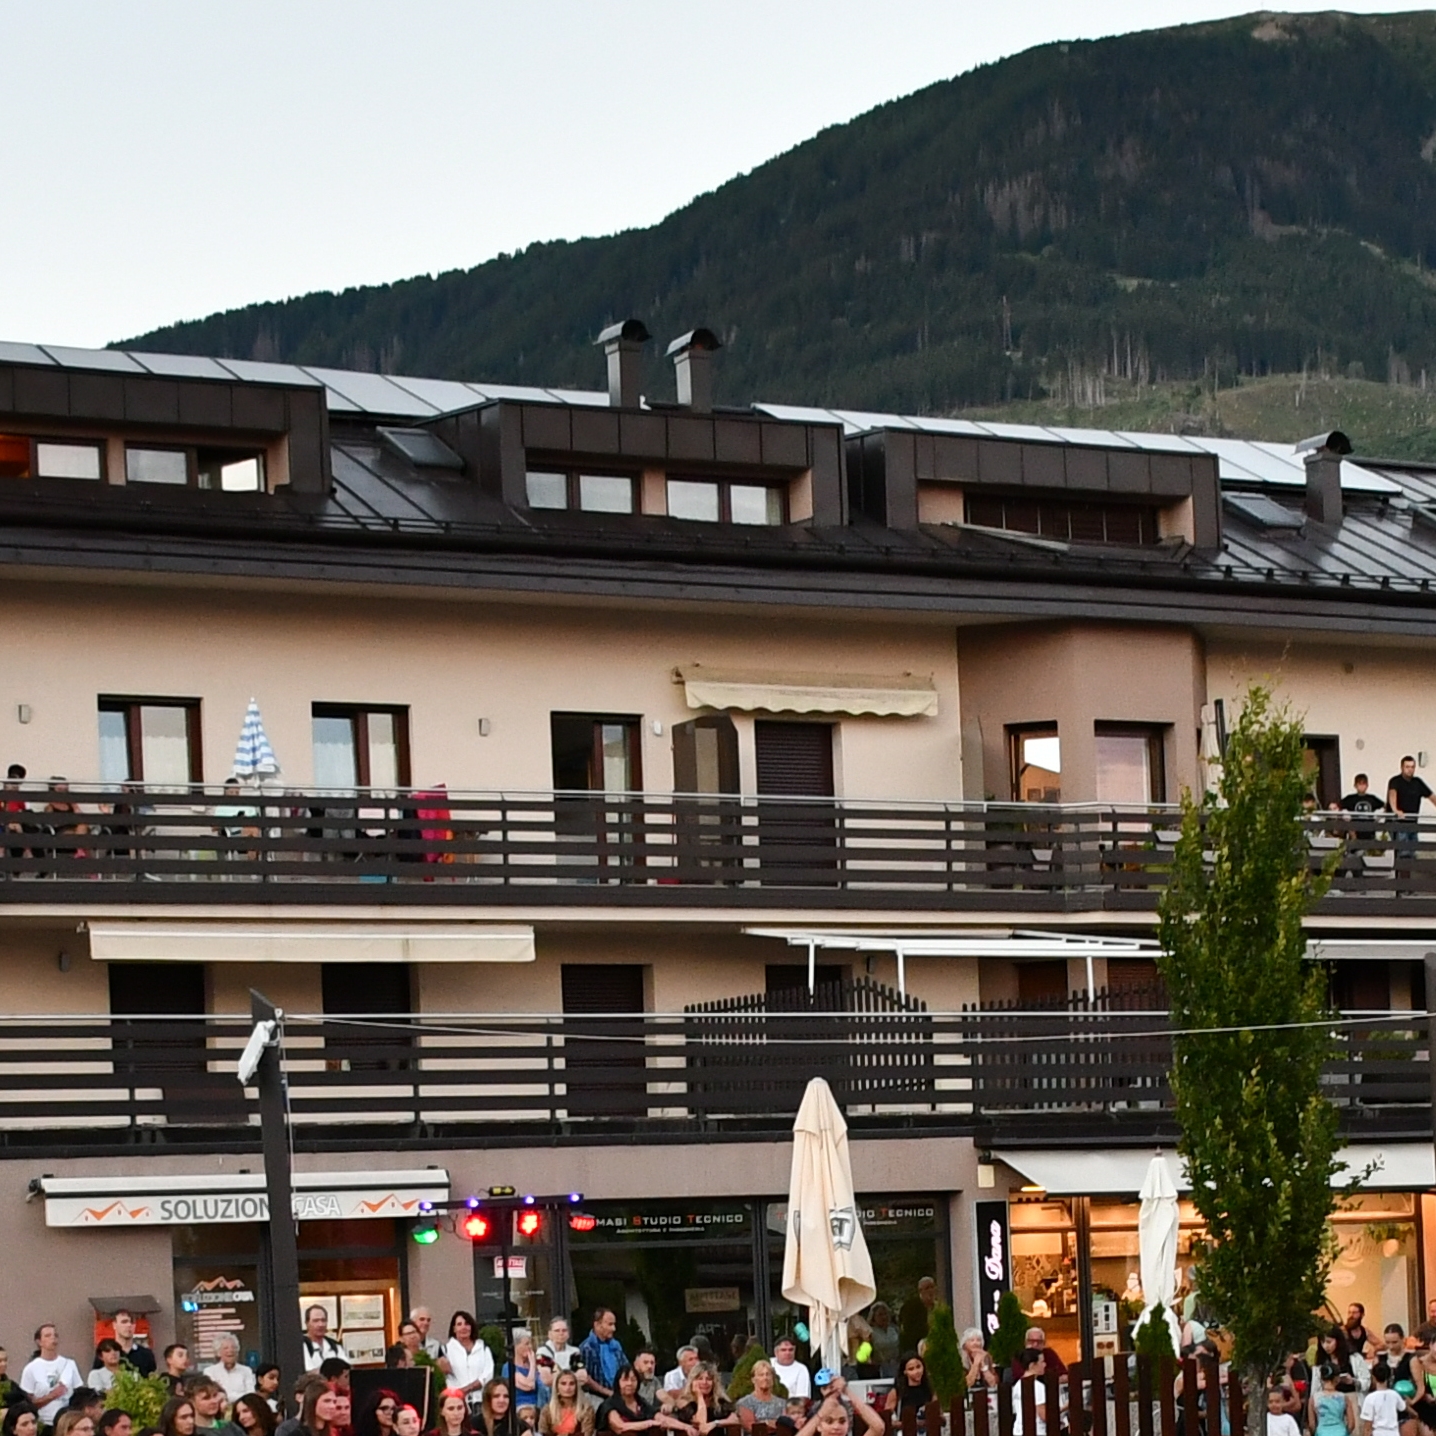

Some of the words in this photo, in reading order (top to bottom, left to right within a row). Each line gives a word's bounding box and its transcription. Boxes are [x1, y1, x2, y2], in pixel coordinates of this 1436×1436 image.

[160, 1197, 271, 1220] SOLUZION
[292, 1194, 343, 1218] CASA
[880, 1206, 935, 1218] TECNICO
[632, 1214, 682, 1227] STUDIO
[686, 1213, 744, 1225] TECNICO
